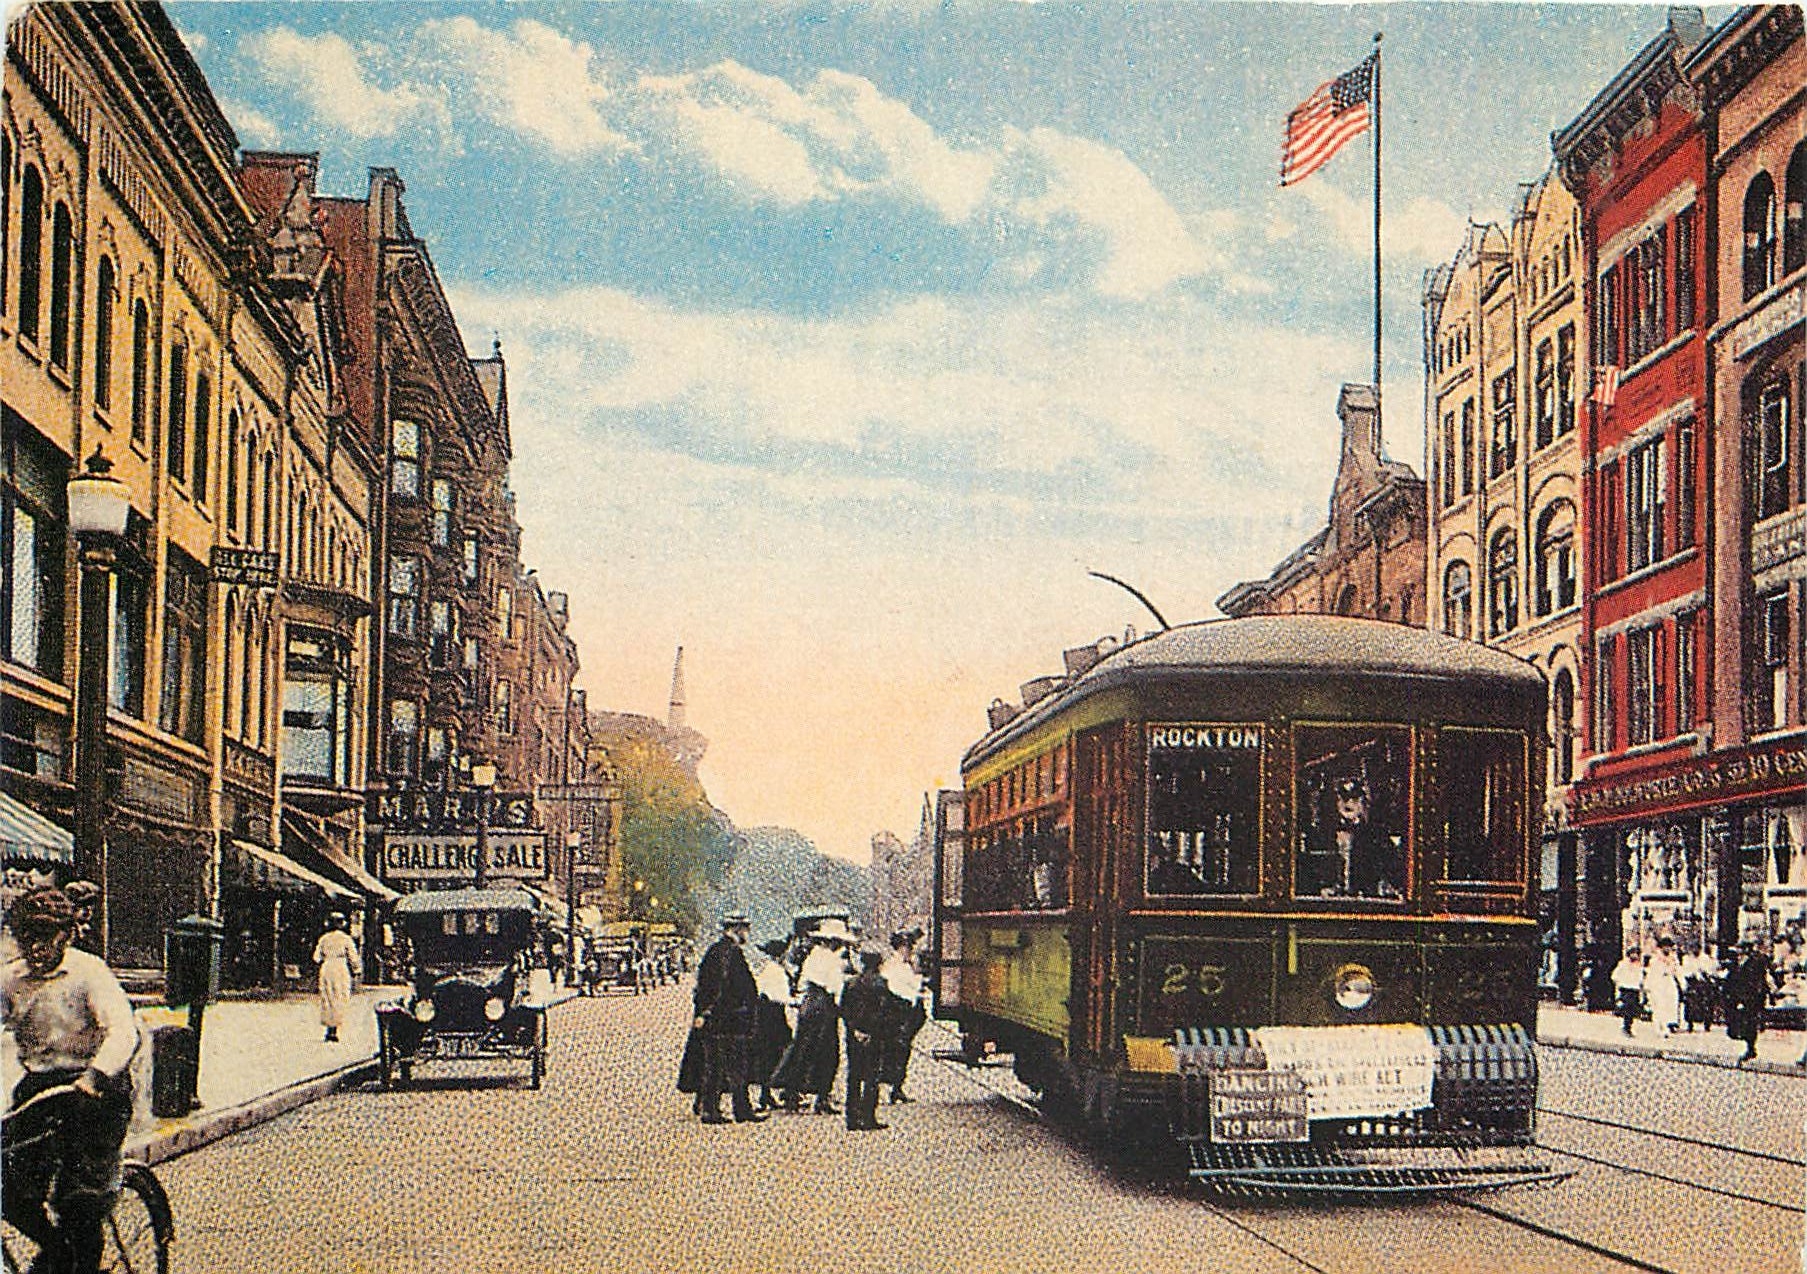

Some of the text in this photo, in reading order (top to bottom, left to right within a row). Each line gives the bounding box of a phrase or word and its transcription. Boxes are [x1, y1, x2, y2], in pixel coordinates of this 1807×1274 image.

[1152, 727, 1259, 748] ROCKTON
[387, 842, 542, 870] CHALLENG SALE
[1161, 962, 1226, 996] 25
[1221, 1119, 1242, 1137] TO
